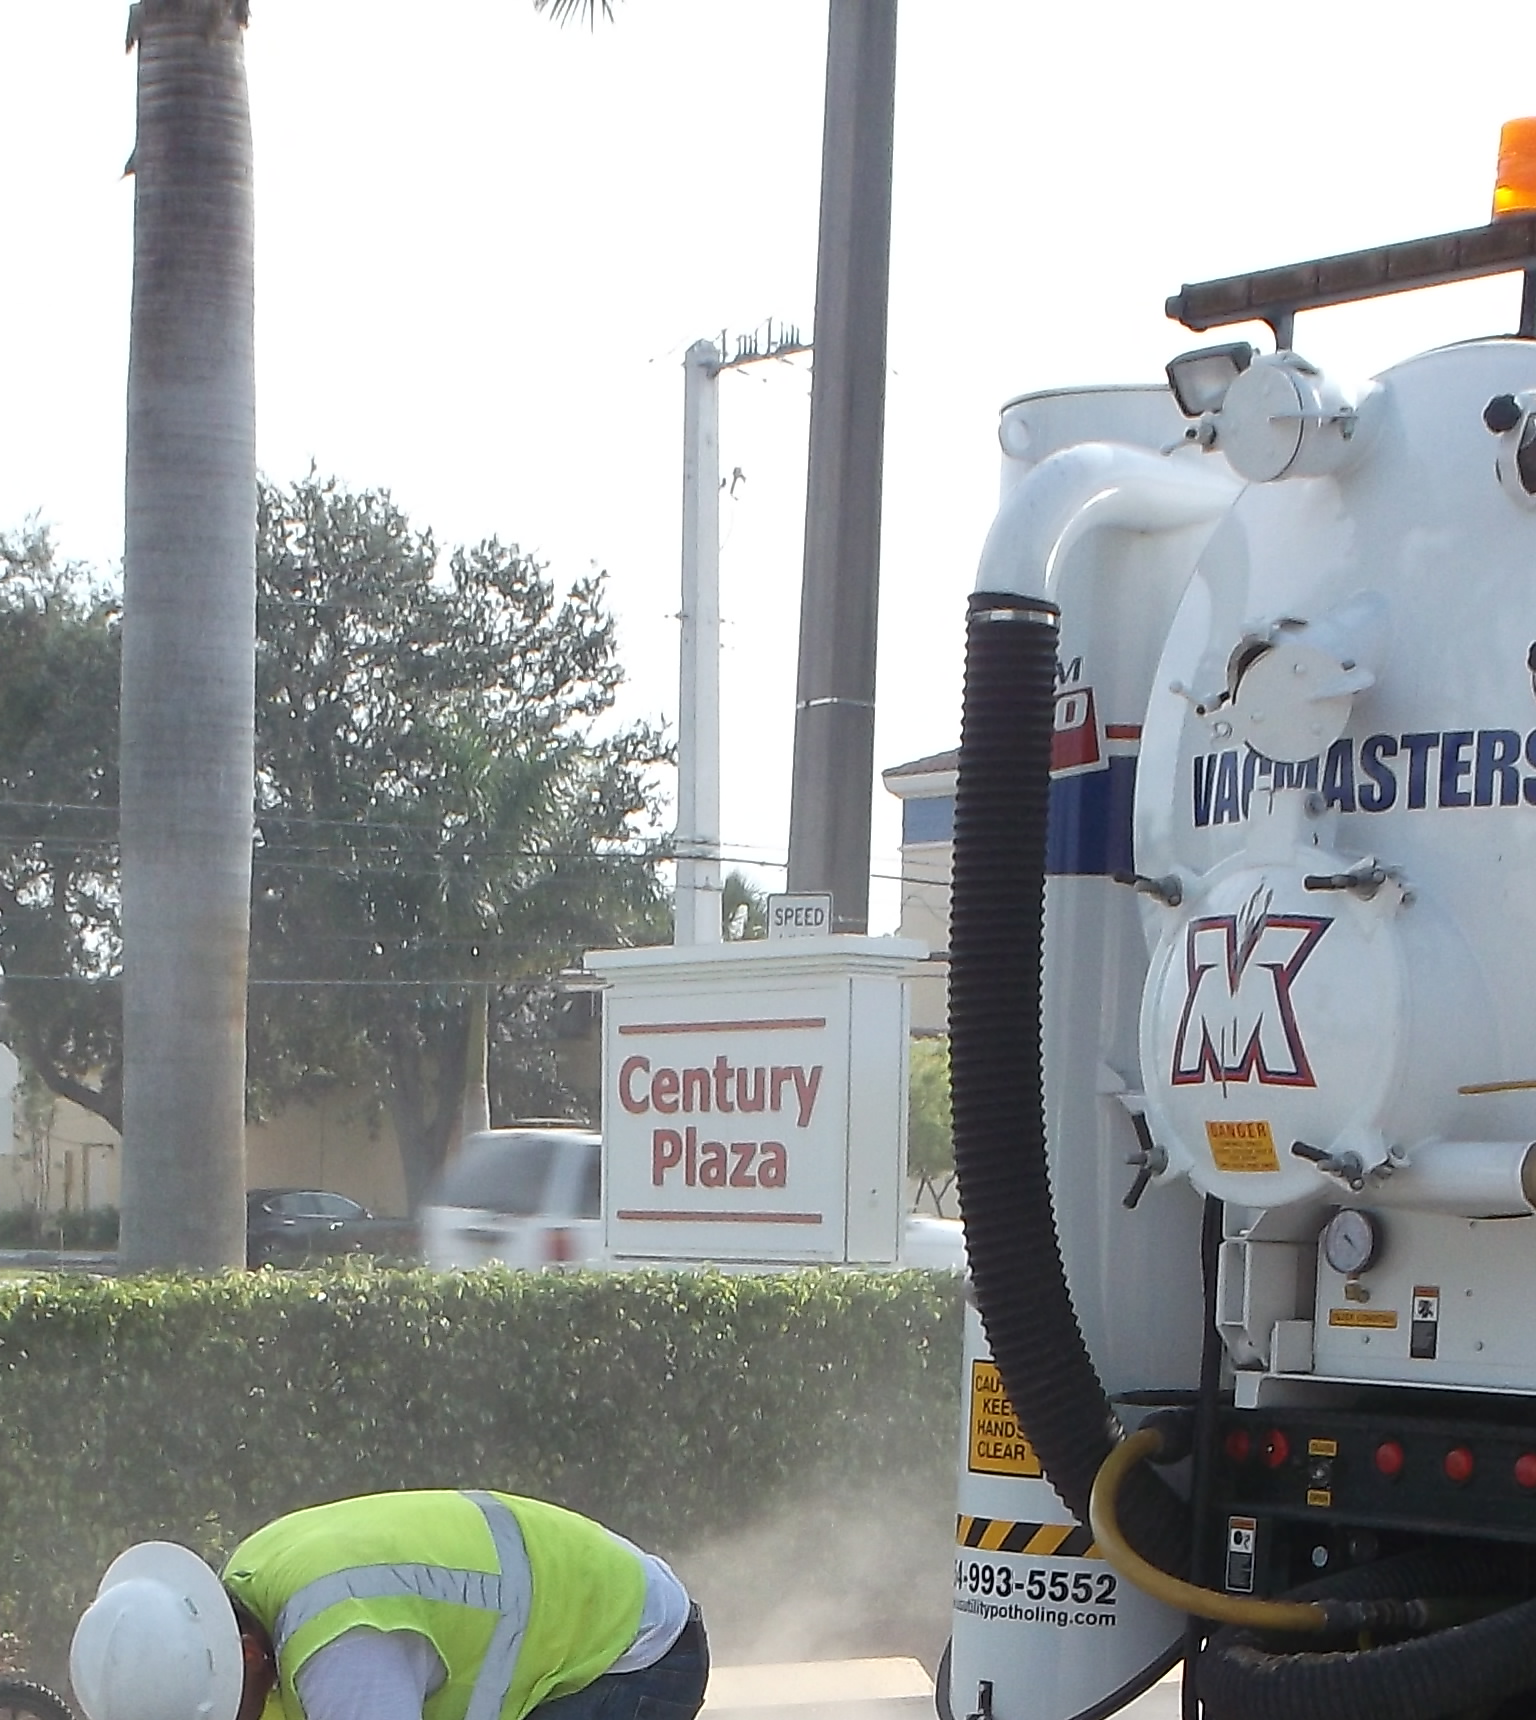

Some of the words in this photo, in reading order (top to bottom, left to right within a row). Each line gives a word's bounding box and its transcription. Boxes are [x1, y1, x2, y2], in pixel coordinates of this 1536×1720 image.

[775, 907, 824, 926] SPEED
[618, 1055, 823, 1127] Century
[652, 1127, 787, 1188] Plaza
[982, 1398, 1013, 1416] KEE
[977, 1441, 1025, 1461] CLEAR
